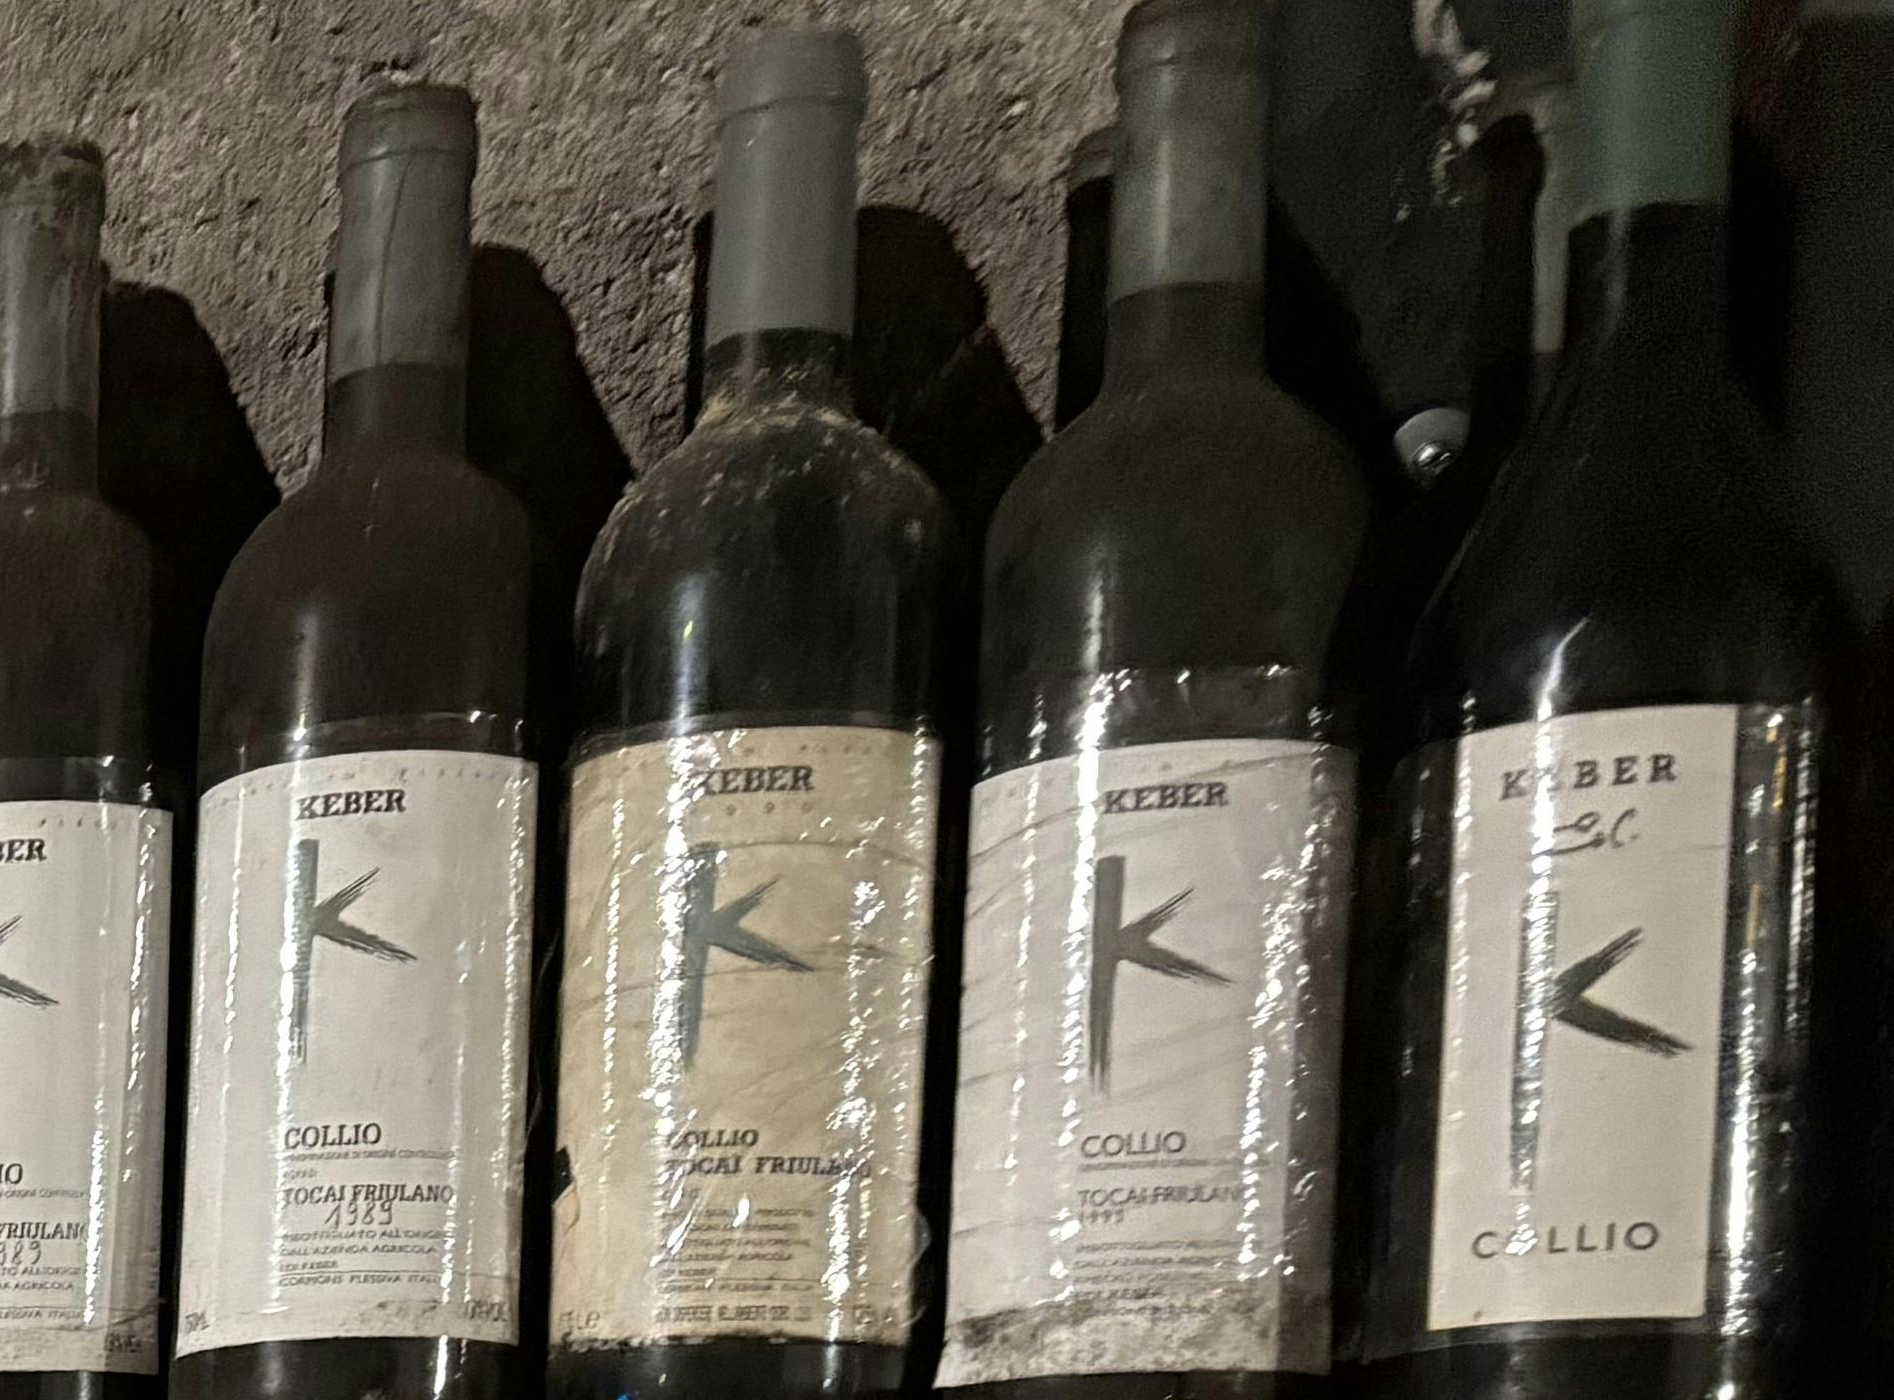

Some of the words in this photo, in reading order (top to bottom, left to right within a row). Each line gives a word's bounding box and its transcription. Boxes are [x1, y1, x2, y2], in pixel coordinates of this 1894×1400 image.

[1499, 754, 1678, 801] KBER
[294, 788, 407, 821] KEBER
[1102, 781, 1229, 814] KEBER
[284, 1122, 382, 1150] COLLIO
[1080, 1131, 1187, 1158] COLLIO
[281, 1185, 346, 1205] TOCAI
[352, 1184, 454, 1203] FRIULANO
[325, 1201, 393, 1229] 1989
